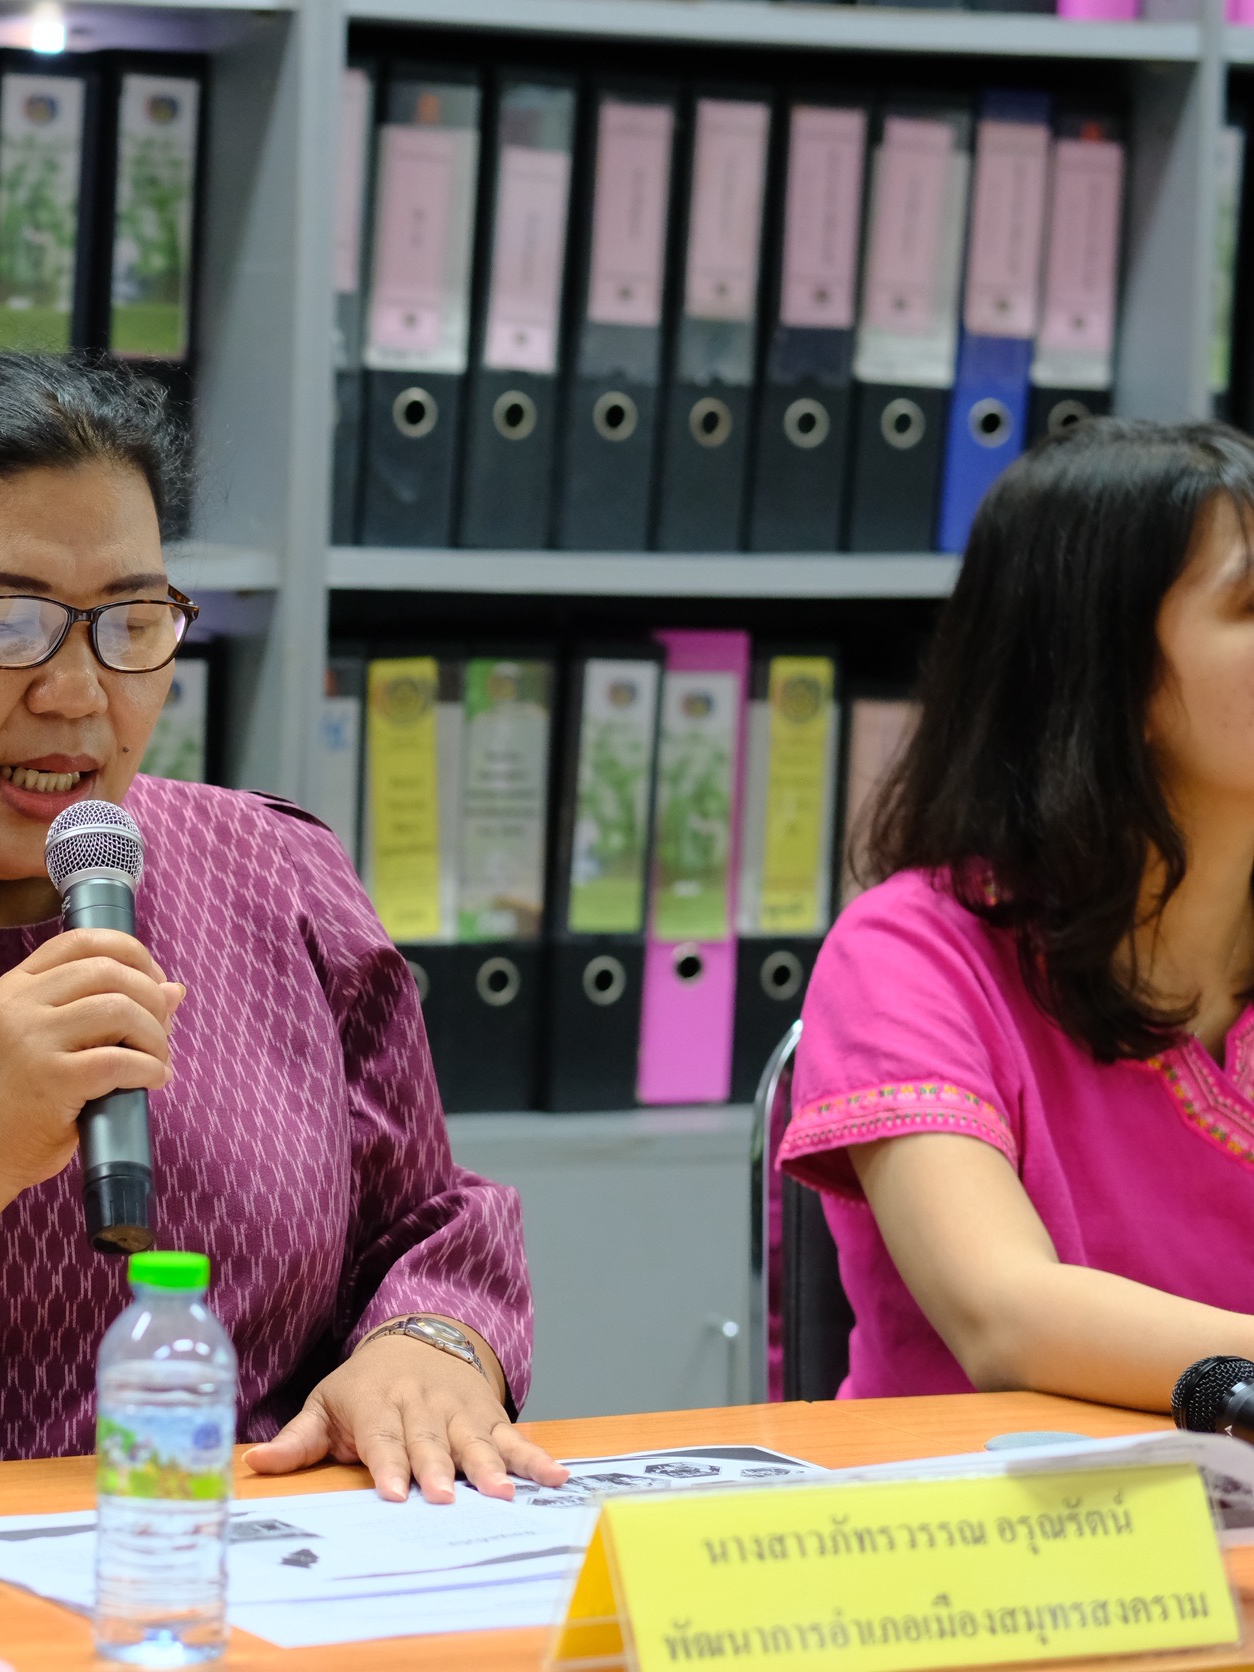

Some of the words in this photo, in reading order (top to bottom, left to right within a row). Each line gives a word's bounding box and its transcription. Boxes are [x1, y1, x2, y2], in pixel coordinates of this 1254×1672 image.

[702, 1514, 988, 1565] นางสาวภัทรวรรณ
[996, 1489, 1134, 1555] อรุณรัตน์
[663, 1591, 1210, 1663] พัฒนาการอำเภอเมืองสมุทรสงคราม
